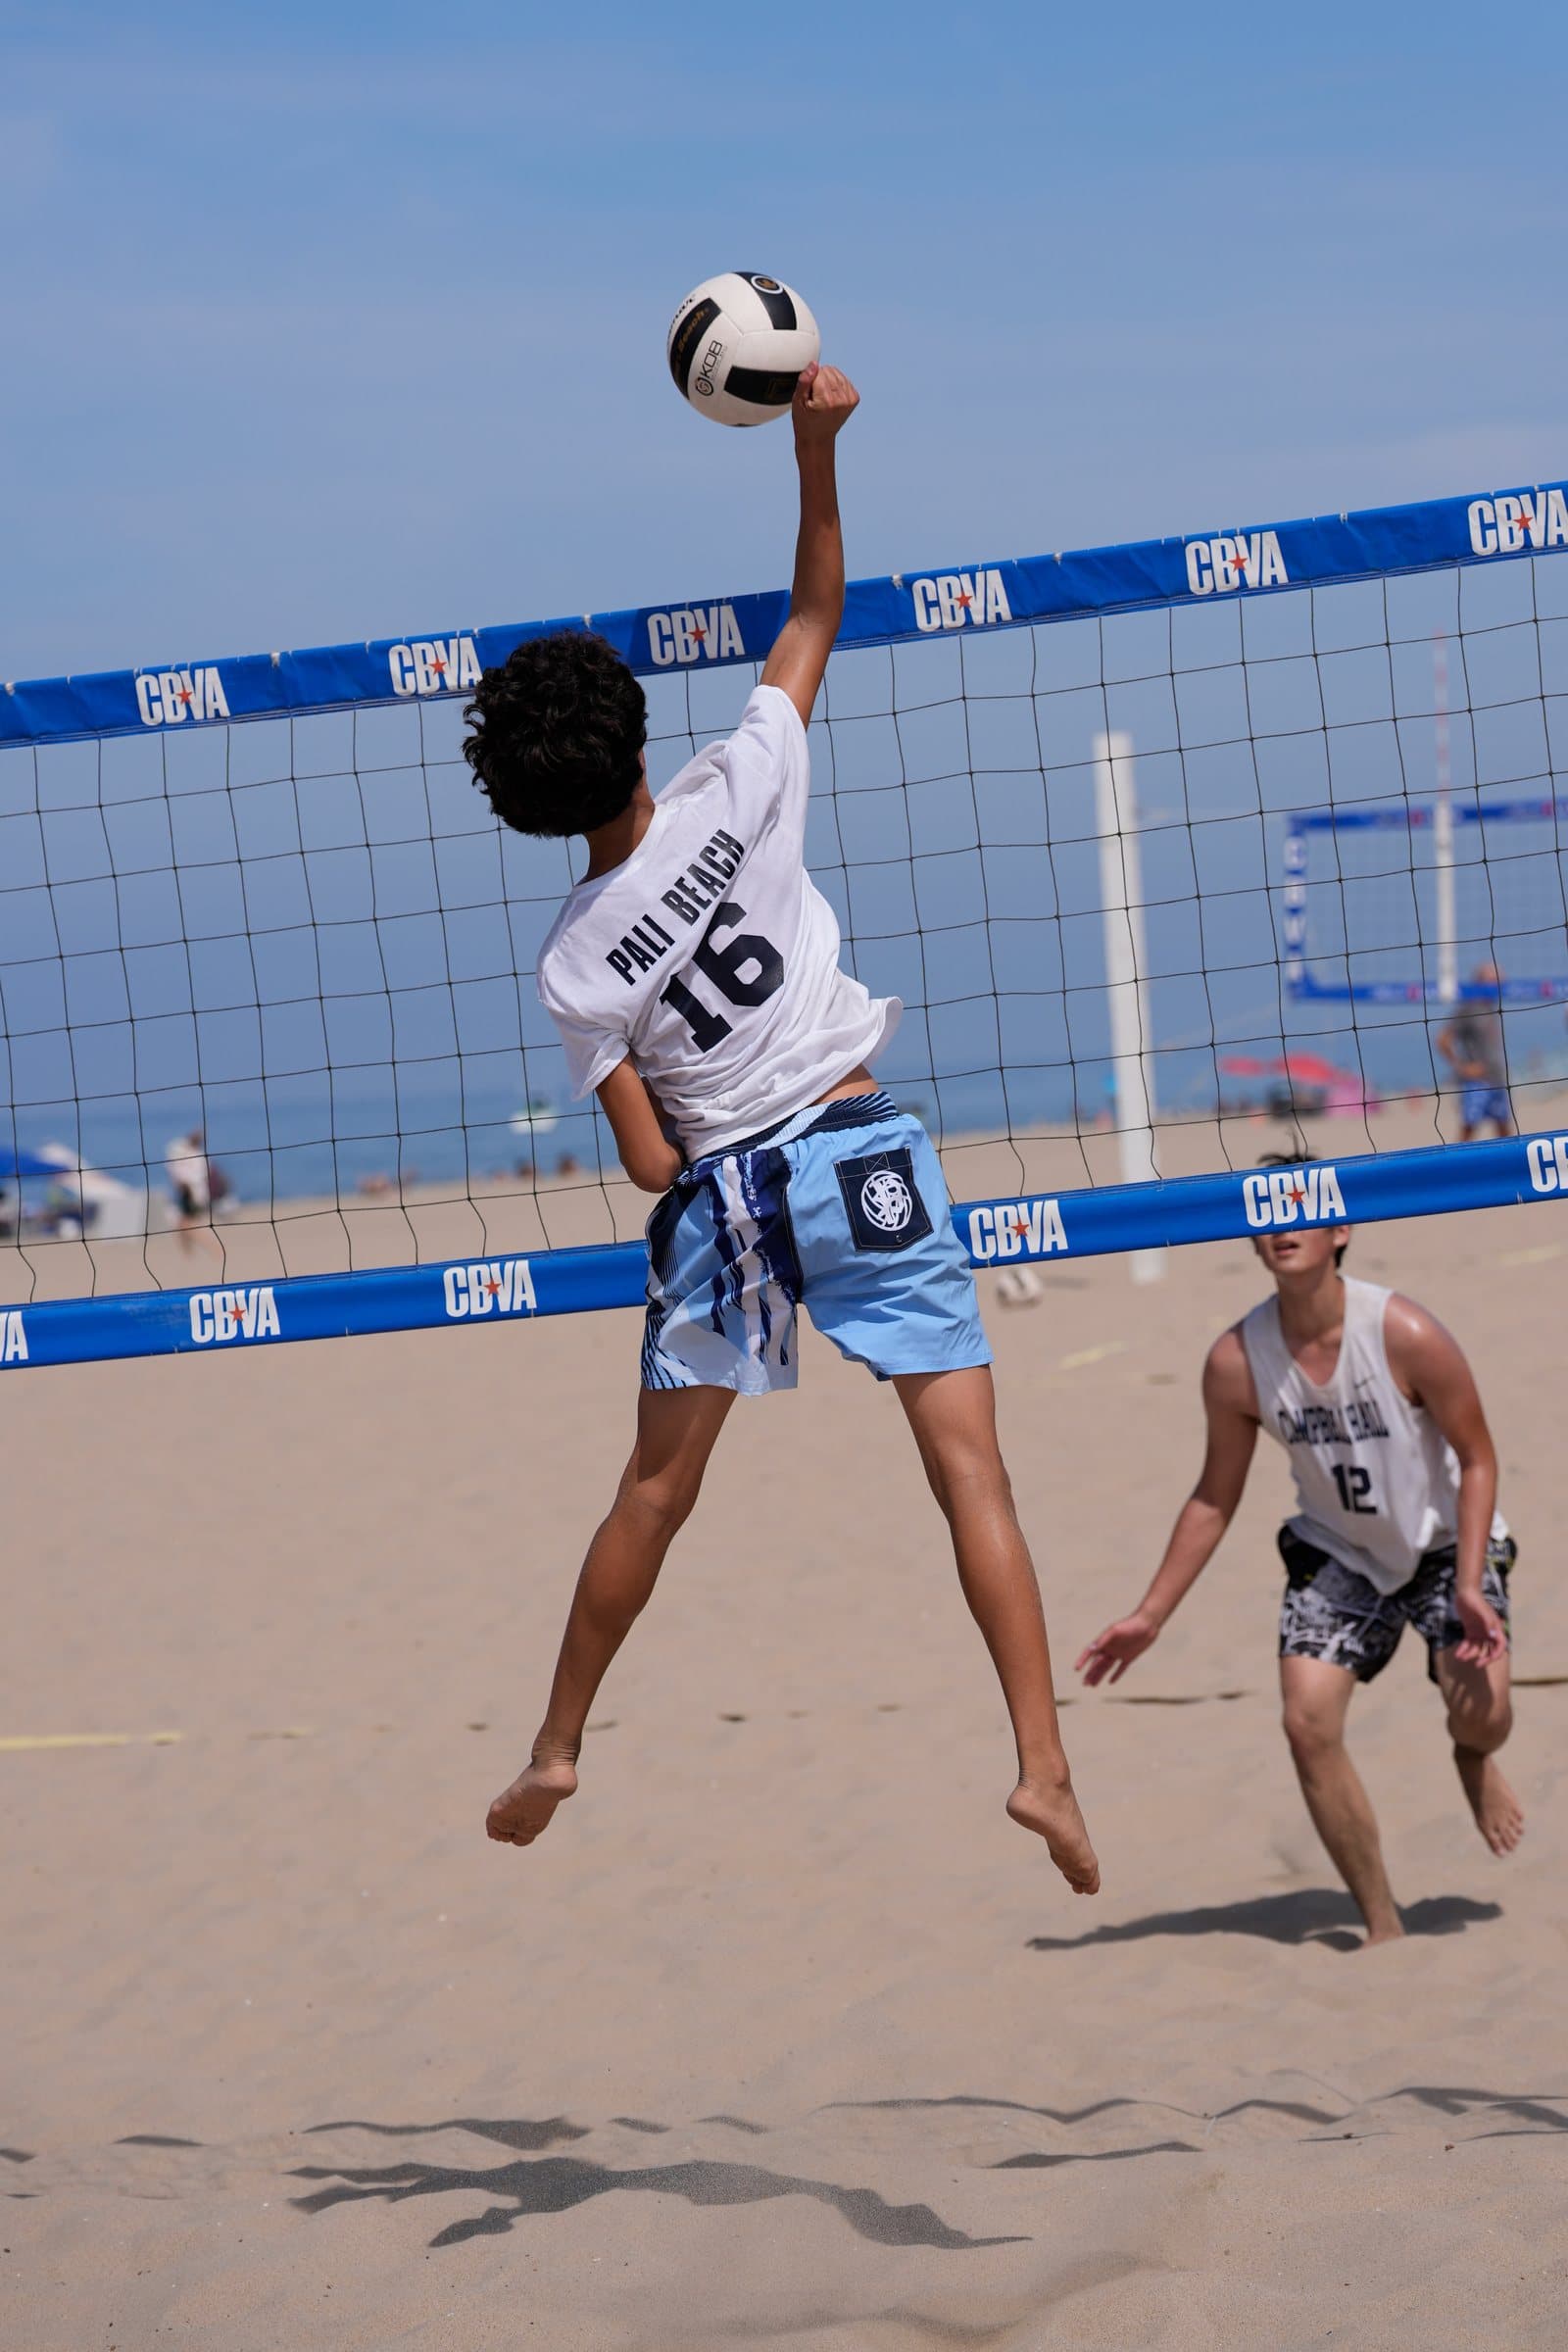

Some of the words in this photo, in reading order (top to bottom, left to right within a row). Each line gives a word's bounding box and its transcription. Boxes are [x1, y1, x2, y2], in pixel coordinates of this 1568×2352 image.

[700, 340, 723, 378] KOB
[1468, 489, 1568, 556] CBVA
[1185, 531, 1289, 596] CBVA
[913, 569, 1012, 631] CBVA
[648, 606, 745, 665] CBVA
[135, 667, 230, 726] CBVA
[389, 637, 481, 697] CBVA
[606, 913, 676, 986] PALI
[660, 829, 746, 926] BEACH
[659, 902, 785, 1054] 16
[1243, 1167, 1347, 1228] CBVA
[968, 1200, 1068, 1260] CBVA
[189, 1287, 281, 1344] CBVA
[443, 1260, 537, 1318] CBVA
[1331, 1463, 1378, 1515] 12
